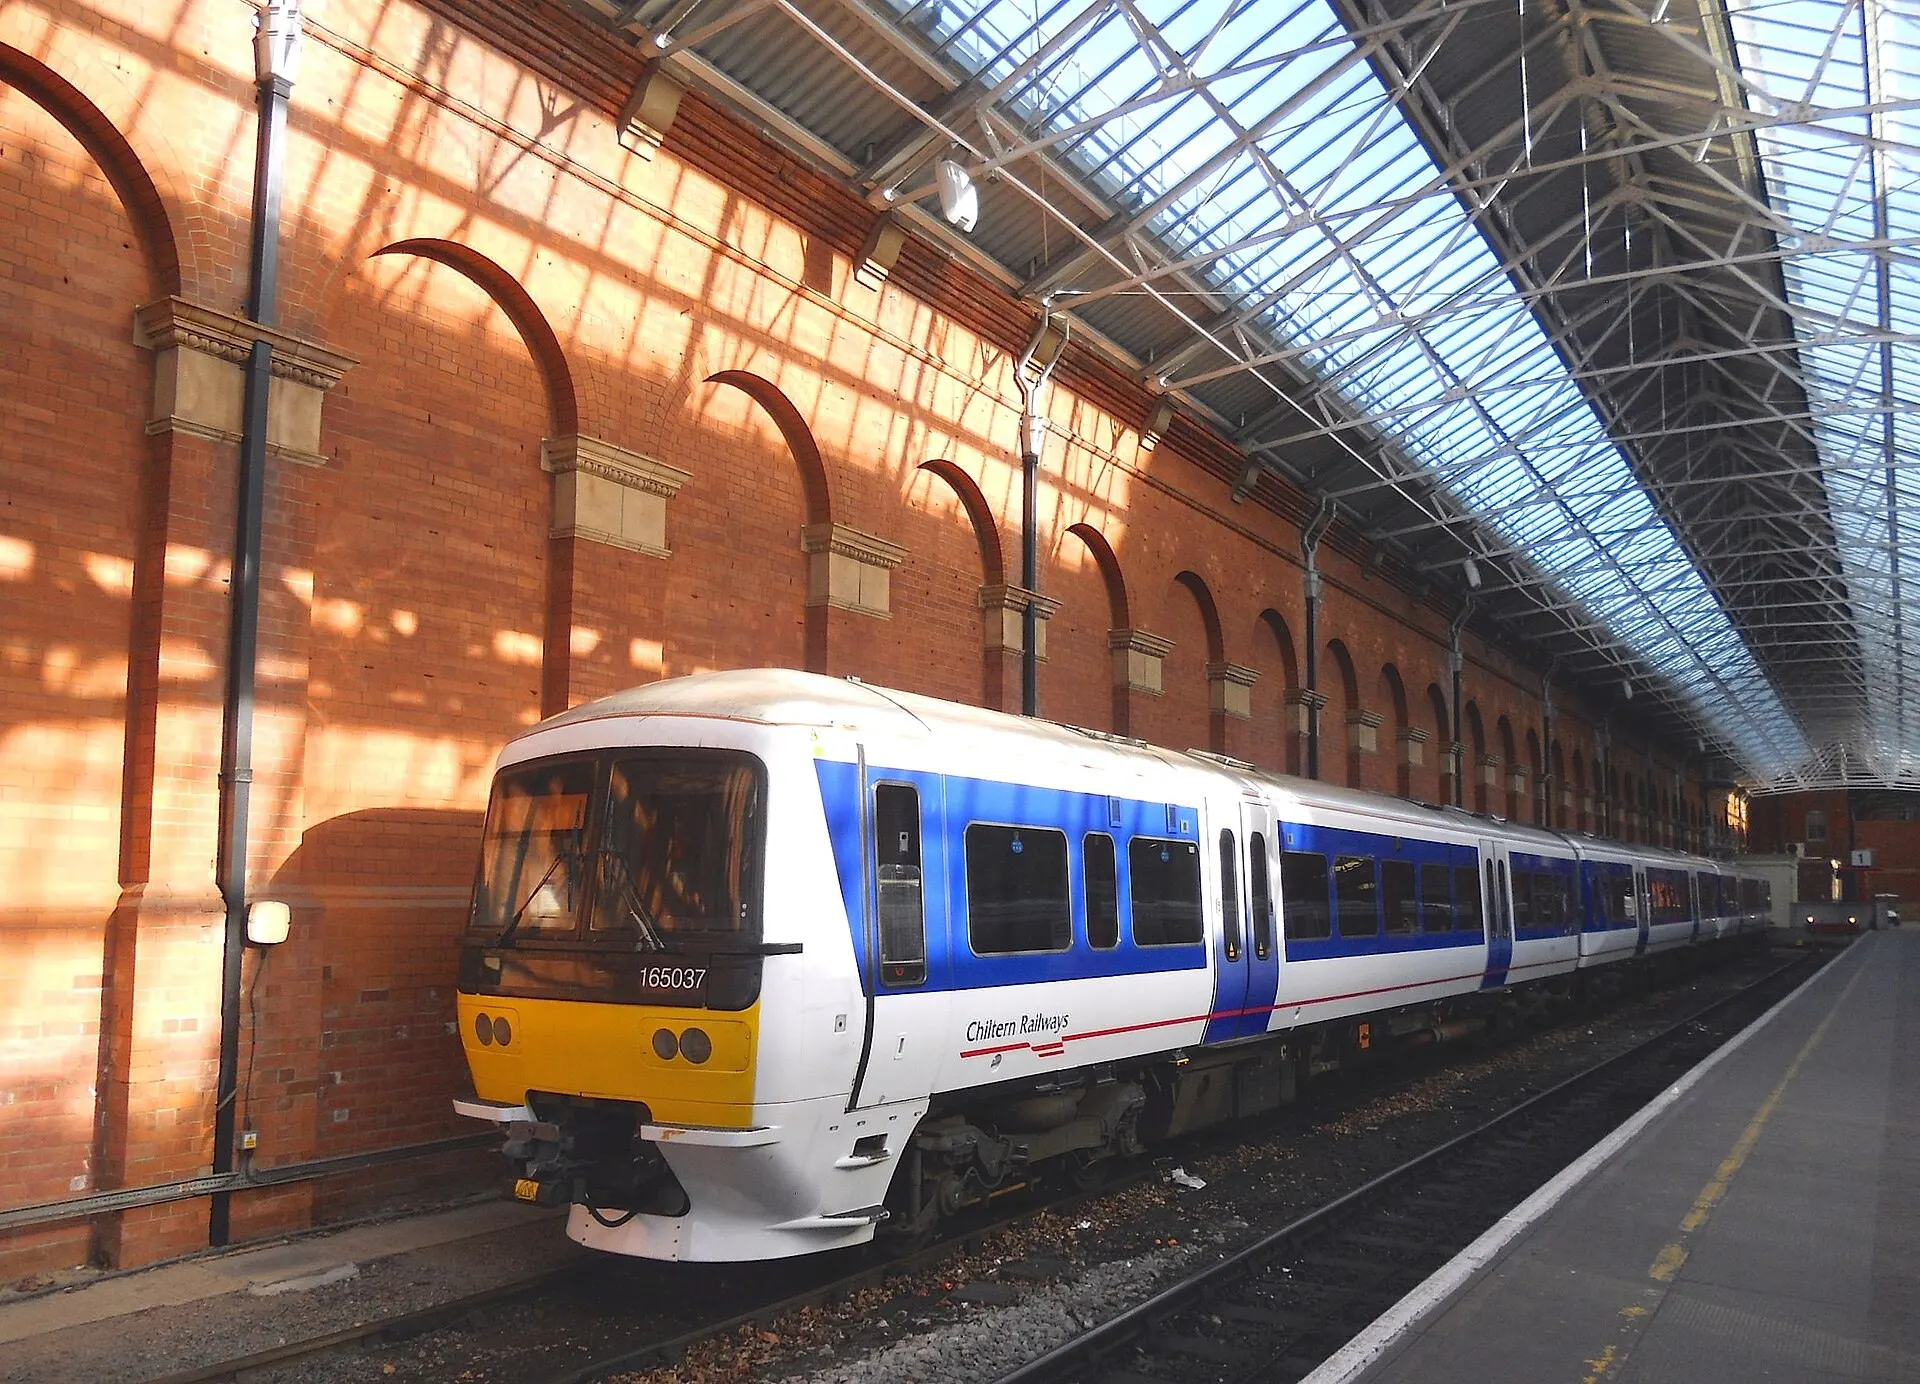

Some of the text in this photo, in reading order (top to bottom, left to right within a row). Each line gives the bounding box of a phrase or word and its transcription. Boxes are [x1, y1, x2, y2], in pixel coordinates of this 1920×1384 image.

[1858, 853, 1863, 864] 1
[640, 967, 706, 989] 165037
[966, 1013, 1069, 1041] Chiltern Railways
